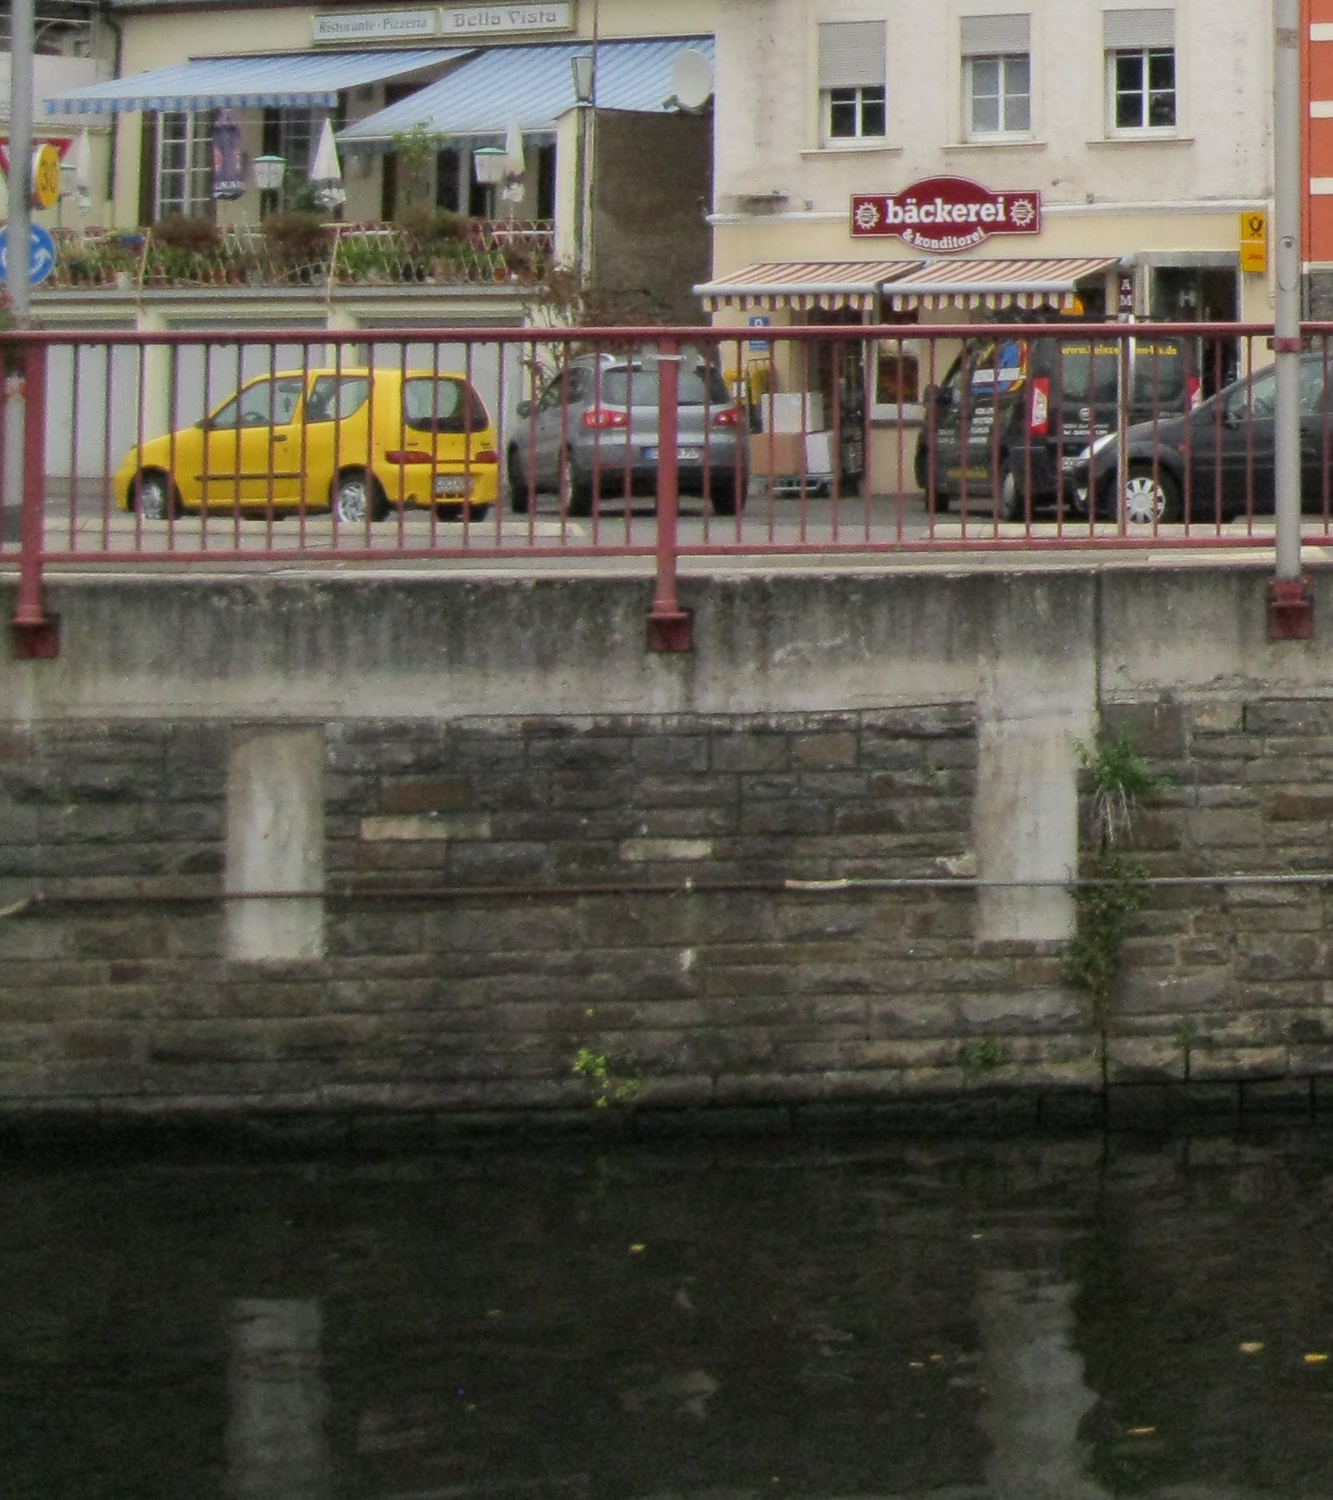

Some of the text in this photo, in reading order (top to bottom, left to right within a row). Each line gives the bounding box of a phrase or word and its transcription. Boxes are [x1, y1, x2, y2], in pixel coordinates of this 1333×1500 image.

[453, 7, 557, 28] Bella Vista
[885, 196, 1006, 224] bäckerei
[902, 226, 986, 250] & konditorei
